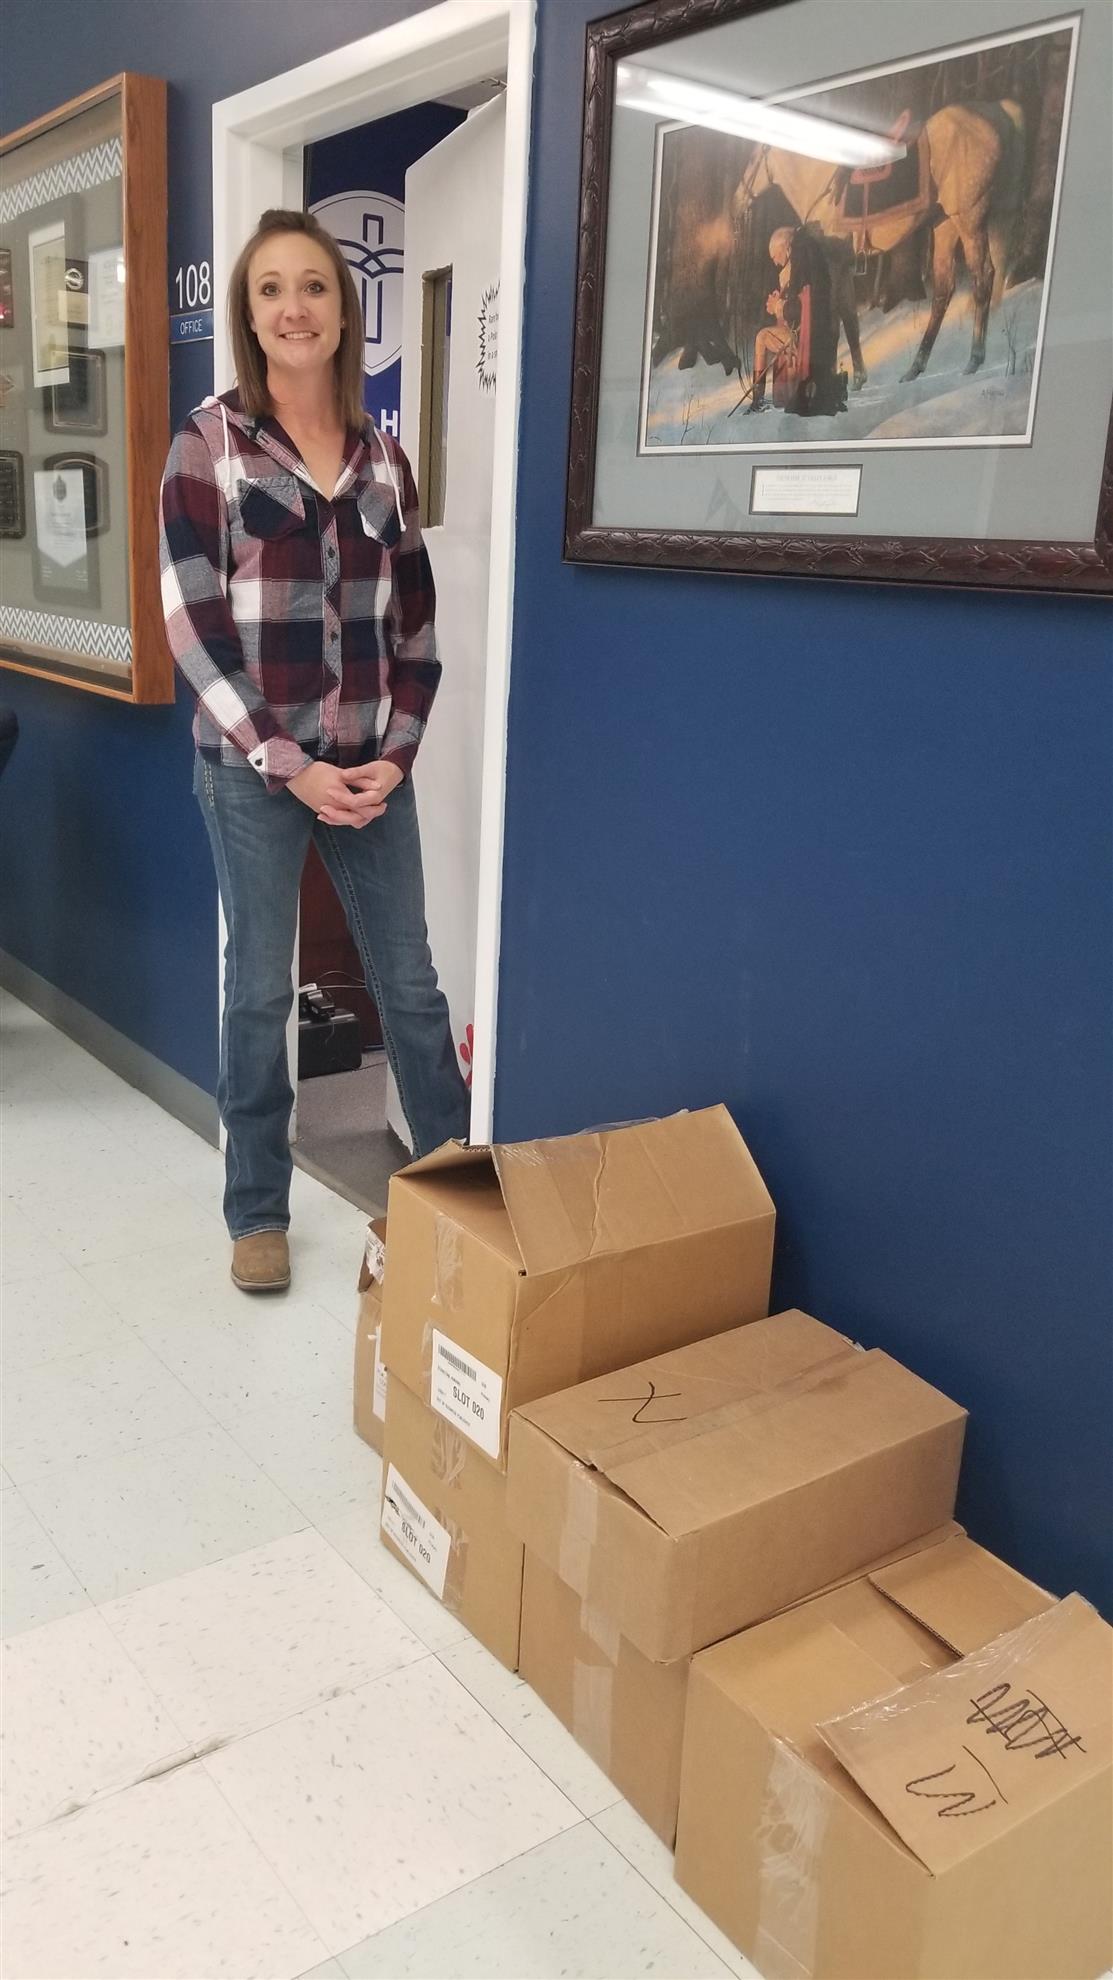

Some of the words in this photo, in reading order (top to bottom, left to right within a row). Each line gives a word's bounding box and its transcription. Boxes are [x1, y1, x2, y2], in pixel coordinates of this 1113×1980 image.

[175, 261, 211, 309] 108
[180, 318, 203, 336] OFFICE
[452, 1385, 471, 1409] SLOT
[471, 1400, 485, 1421] 020
[401, 1521, 417, 1547] SLOT
[418, 1543, 431, 1564] 020
